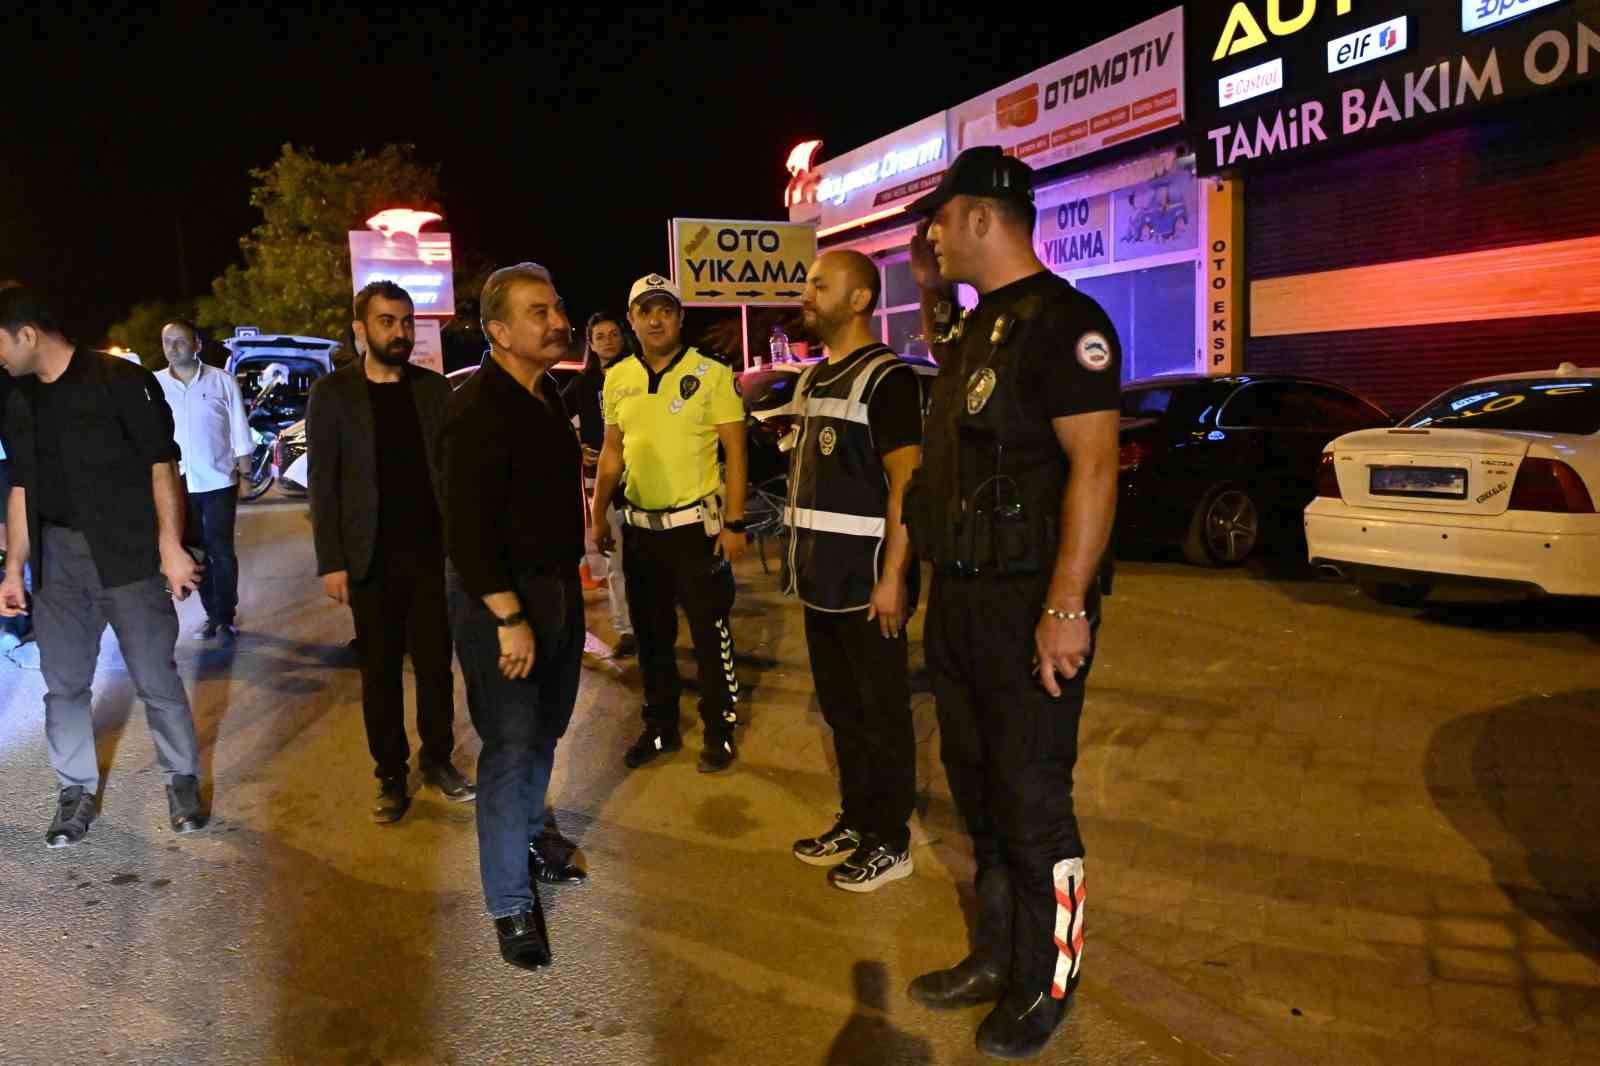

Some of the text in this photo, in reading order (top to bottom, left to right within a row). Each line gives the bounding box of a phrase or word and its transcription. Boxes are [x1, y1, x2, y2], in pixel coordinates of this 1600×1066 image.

[1336, 33, 1371, 65] elf
[1341, 46, 1504, 136] BAKIM
[1057, 199, 1090, 231] OTO
[717, 228, 780, 253] OTO
[1044, 231, 1104, 266] YIKAMA
[685, 258, 808, 284] YIKAMA
[1212, 240, 1226, 290] OTO
